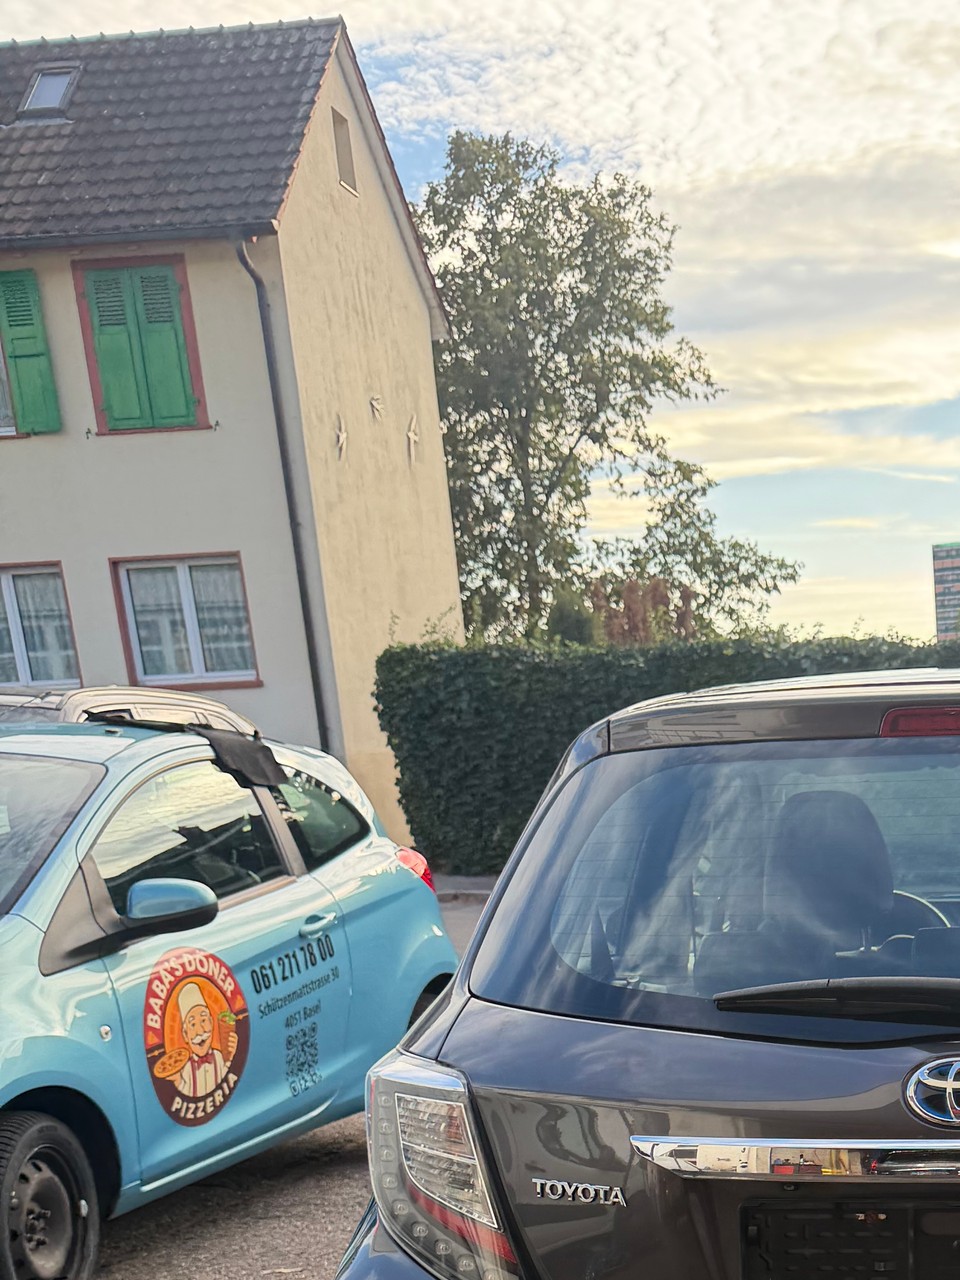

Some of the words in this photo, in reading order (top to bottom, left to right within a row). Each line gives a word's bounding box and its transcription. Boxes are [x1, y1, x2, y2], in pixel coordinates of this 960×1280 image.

[251, 969, 278, 994] 061
[278, 953, 302, 982] 271
[300, 943, 317, 971] 78
[317, 934, 335, 962] 00
[147, 957, 184, 1030] BABA'S
[258, 973, 331, 1019] Schützenmattstrasse
[303, 999, 322, 1020] Basel
[171, 1072, 238, 1119] PIZZERIA
[531, 1178, 627, 1208] TOYOTA
